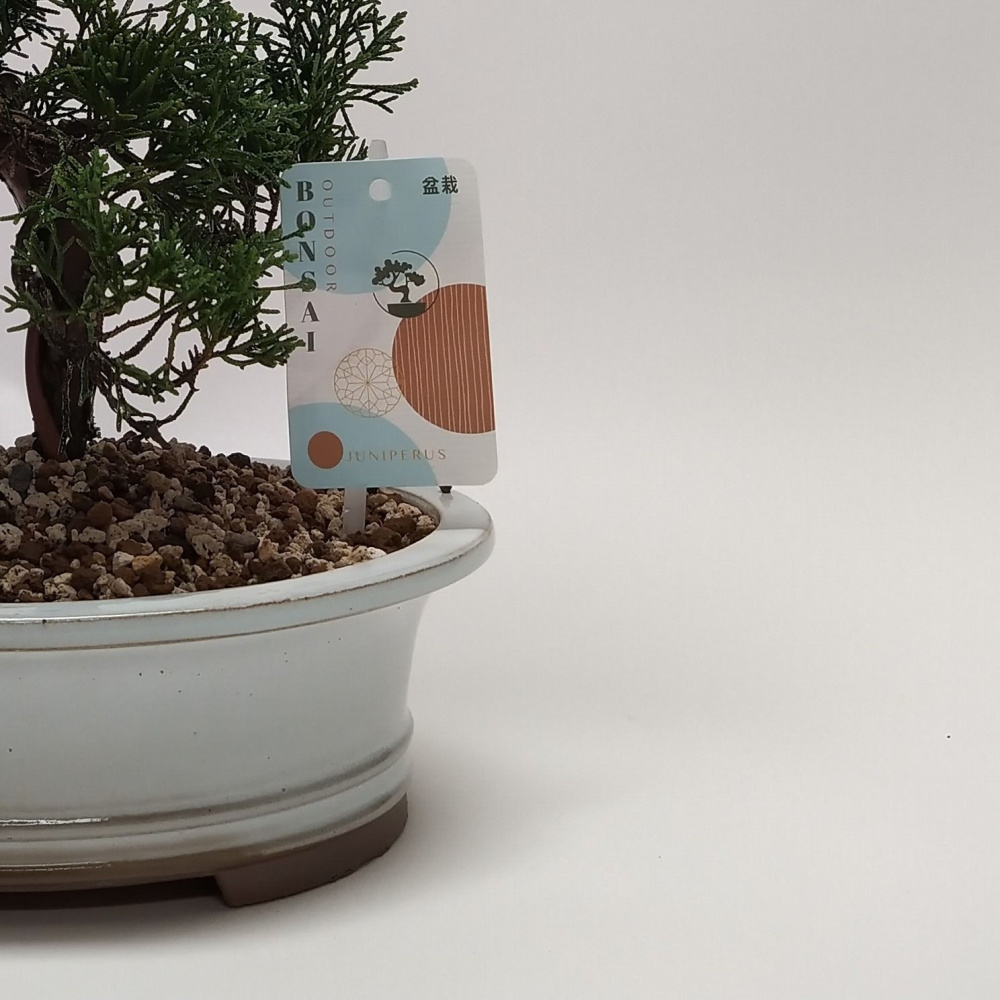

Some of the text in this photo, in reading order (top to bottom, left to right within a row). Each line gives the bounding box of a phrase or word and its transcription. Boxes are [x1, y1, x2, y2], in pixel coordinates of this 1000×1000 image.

[422, 175, 459, 196] 盆栽
[321, 179, 337, 292] OUTDOOR
[346, 448, 447, 462] JUNIPERUS
